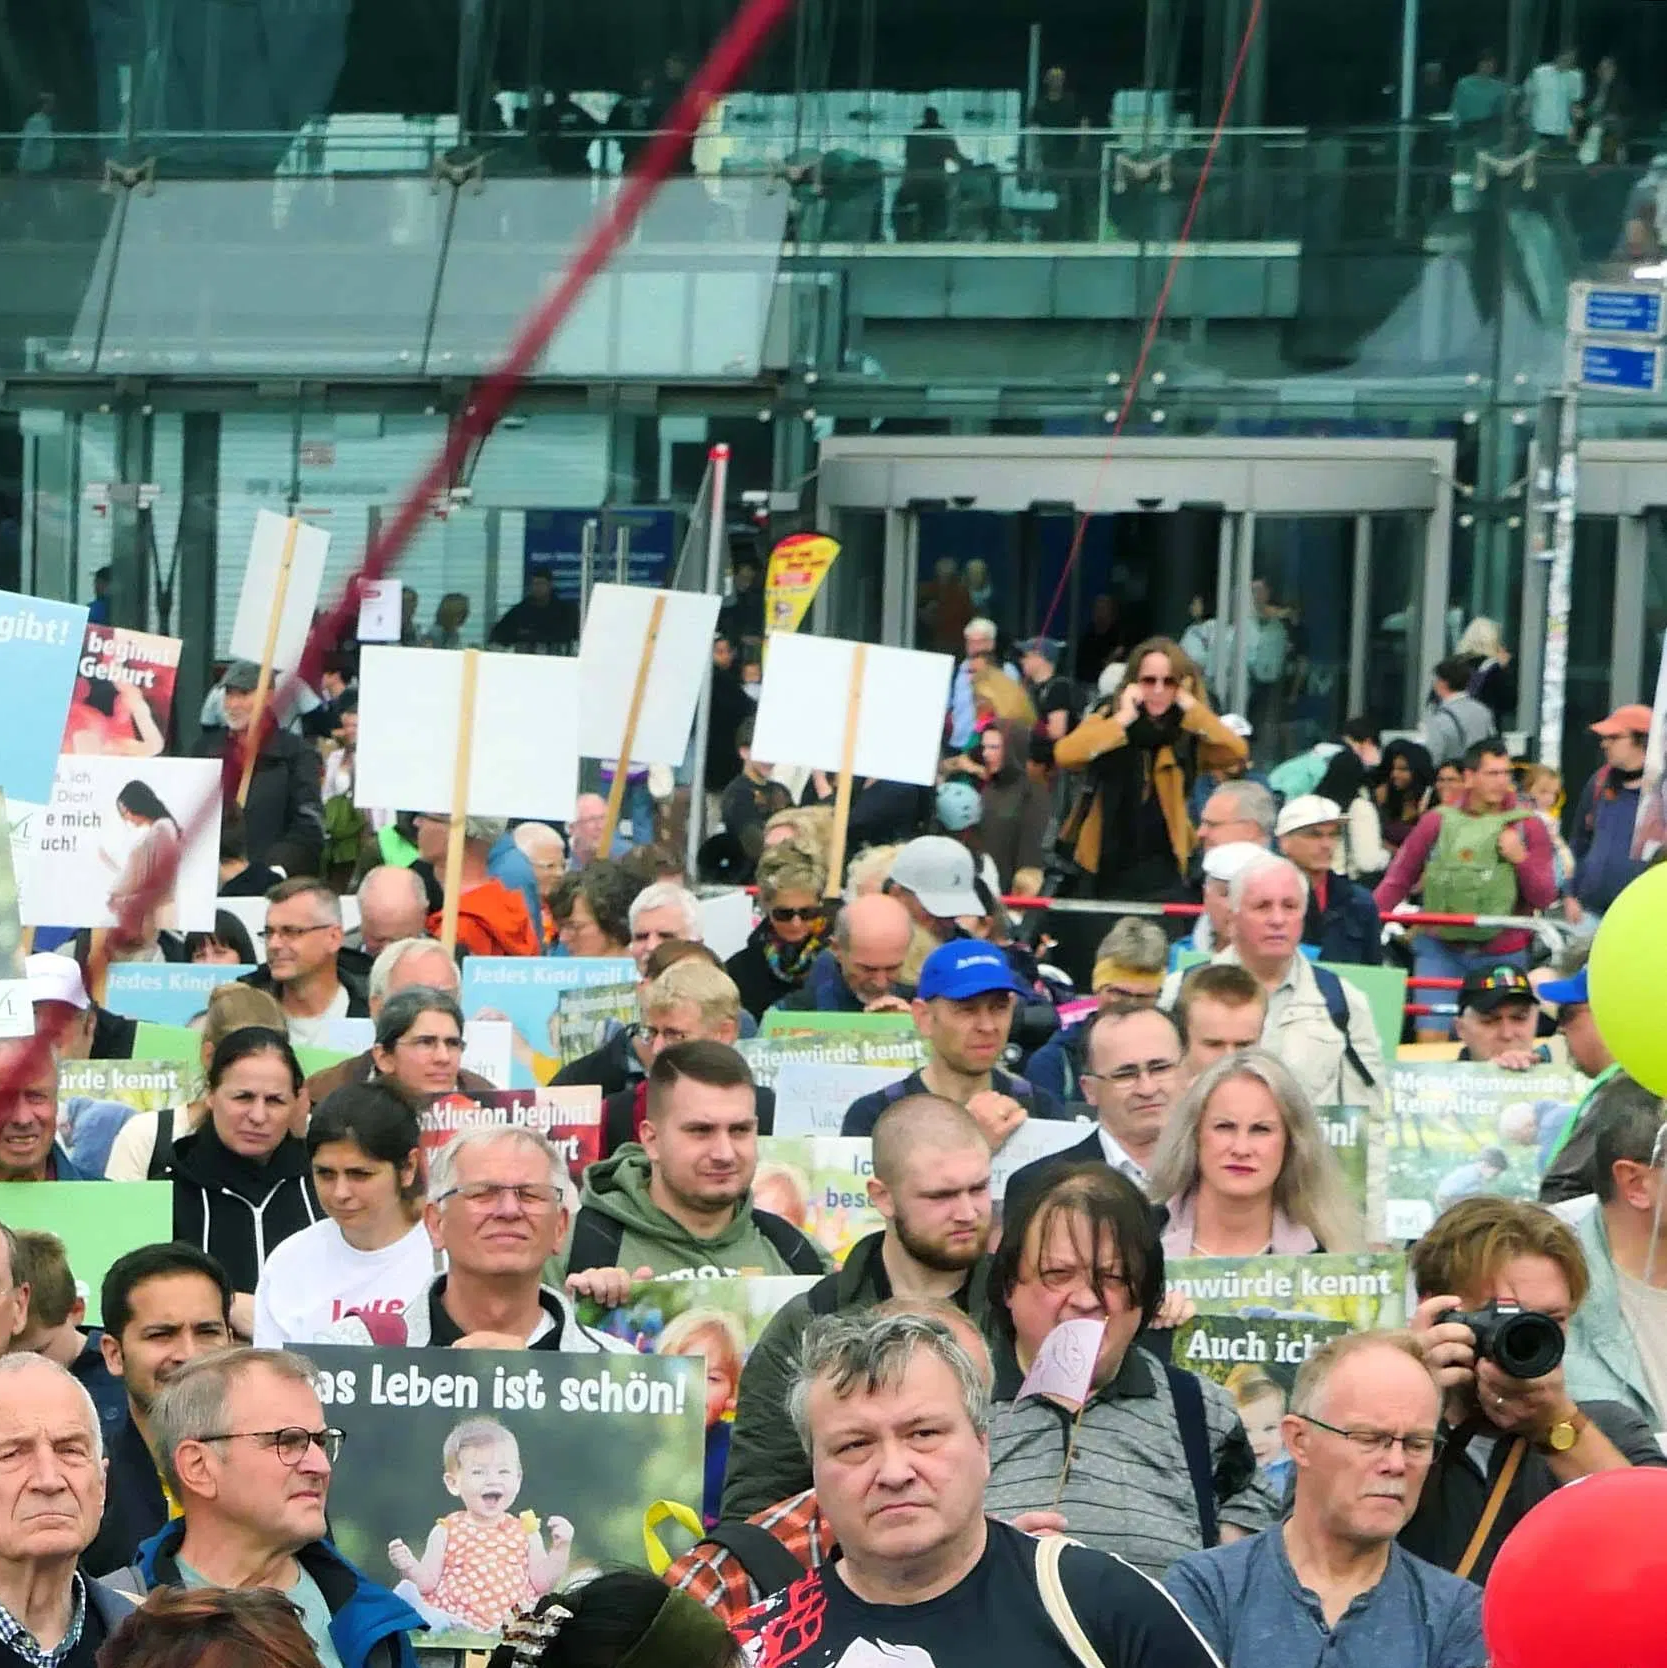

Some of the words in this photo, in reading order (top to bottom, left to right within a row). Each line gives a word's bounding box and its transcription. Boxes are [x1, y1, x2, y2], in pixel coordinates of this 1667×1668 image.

[78, 656, 157, 689] Geburt
[61, 811, 103, 829] mich
[472, 965, 529, 985] Jedes
[532, 965, 579, 985] Kind
[863, 1039, 923, 1062] kennt
[114, 1068, 178, 1090] kennt
[417, 1100, 510, 1131] nklusion
[1300, 1269, 1392, 1296] kennt
[1185, 1329, 1266, 1361] Auch
[370, 1363, 479, 1410] Leben
[493, 1365, 546, 1410] ist
[559, 1369, 688, 1415] schön!
